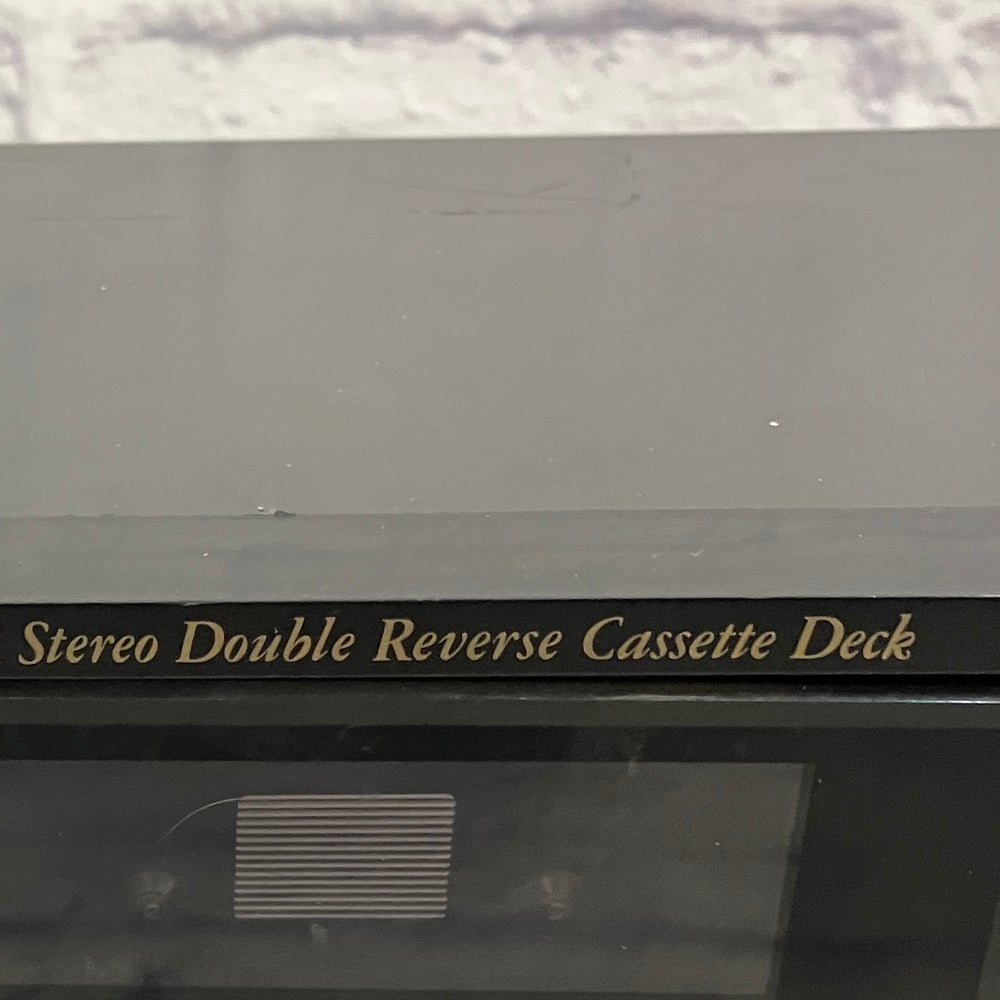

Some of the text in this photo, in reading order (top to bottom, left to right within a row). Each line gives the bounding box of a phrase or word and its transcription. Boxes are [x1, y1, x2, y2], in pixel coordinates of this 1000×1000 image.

[18, 621, 159, 664] Stereo
[176, 617, 356, 664] Double
[372, 617, 563, 662] Reverse
[582, 616, 777, 661] Cassette
[790, 613, 916, 661] Deck
